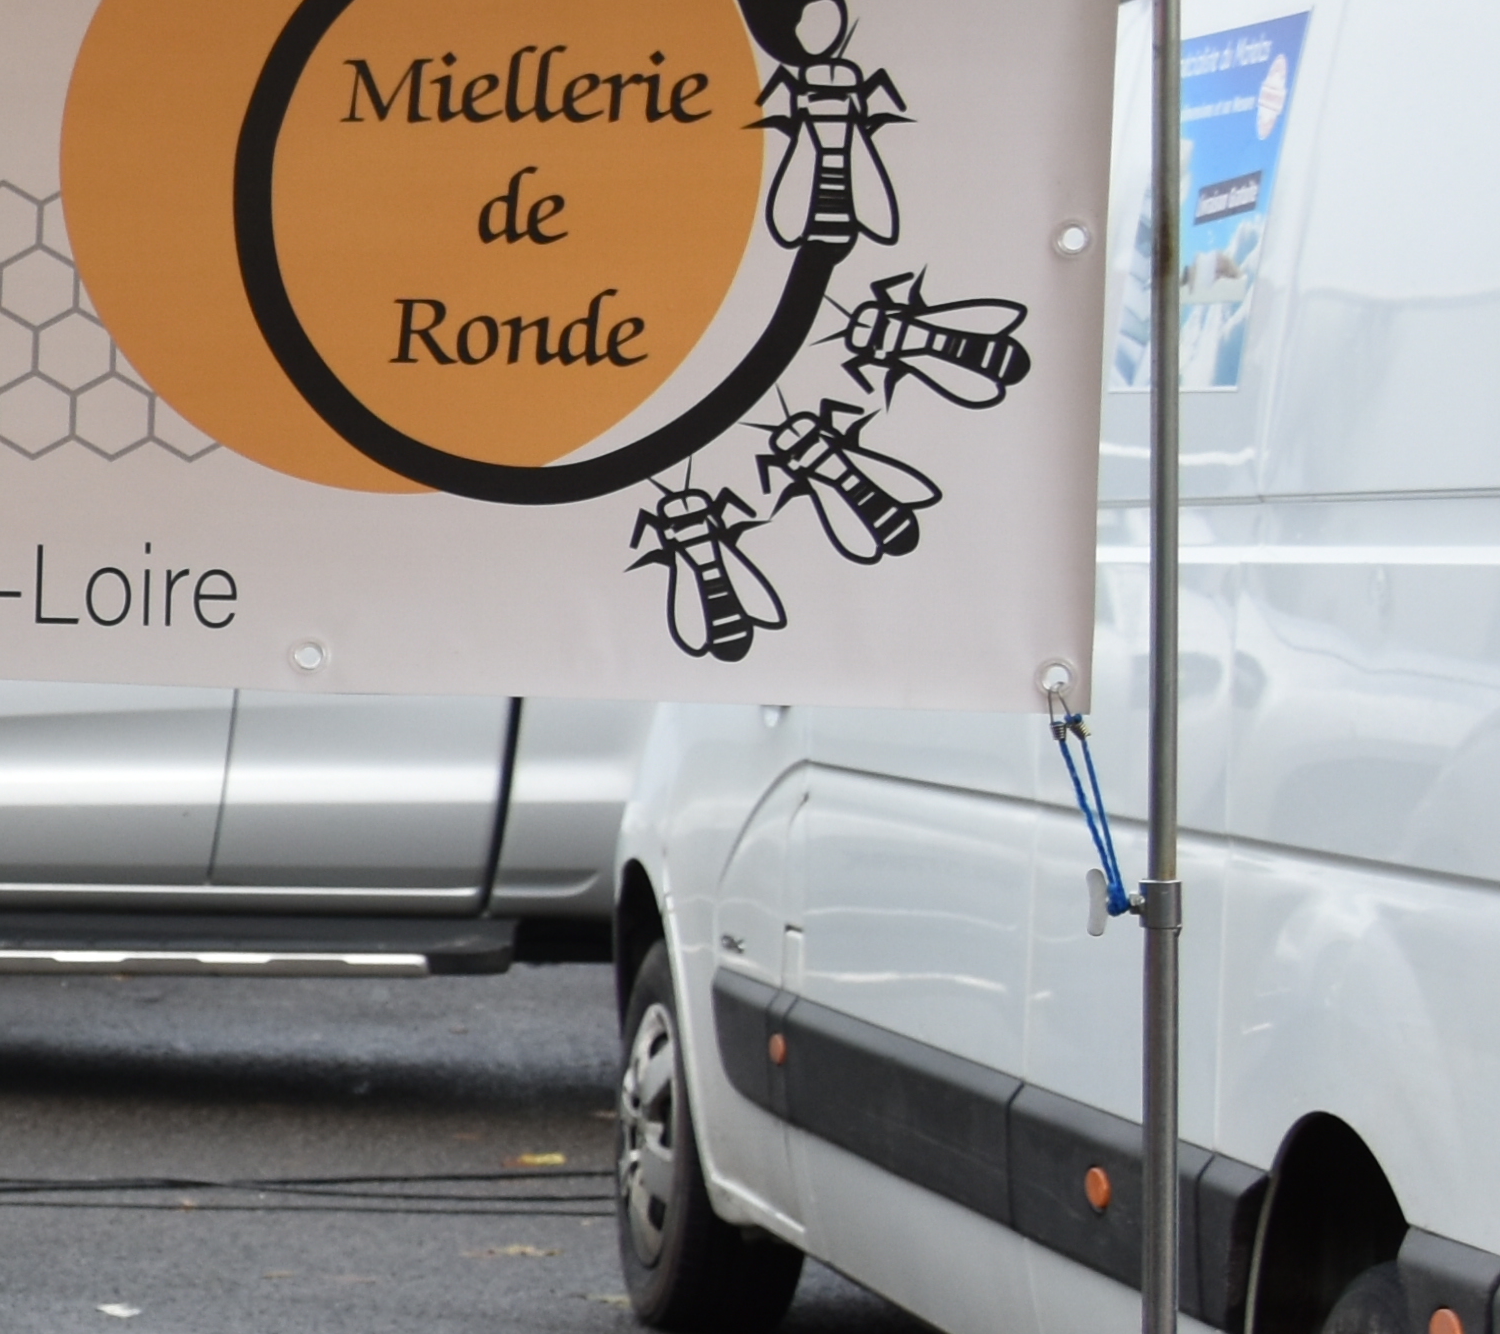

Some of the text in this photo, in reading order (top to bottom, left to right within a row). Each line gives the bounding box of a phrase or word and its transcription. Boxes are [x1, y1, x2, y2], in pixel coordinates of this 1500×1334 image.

[340, 45, 713, 126] Miellerie
[477, 165, 569, 246] de
[390, 288, 648, 370] Ronde
